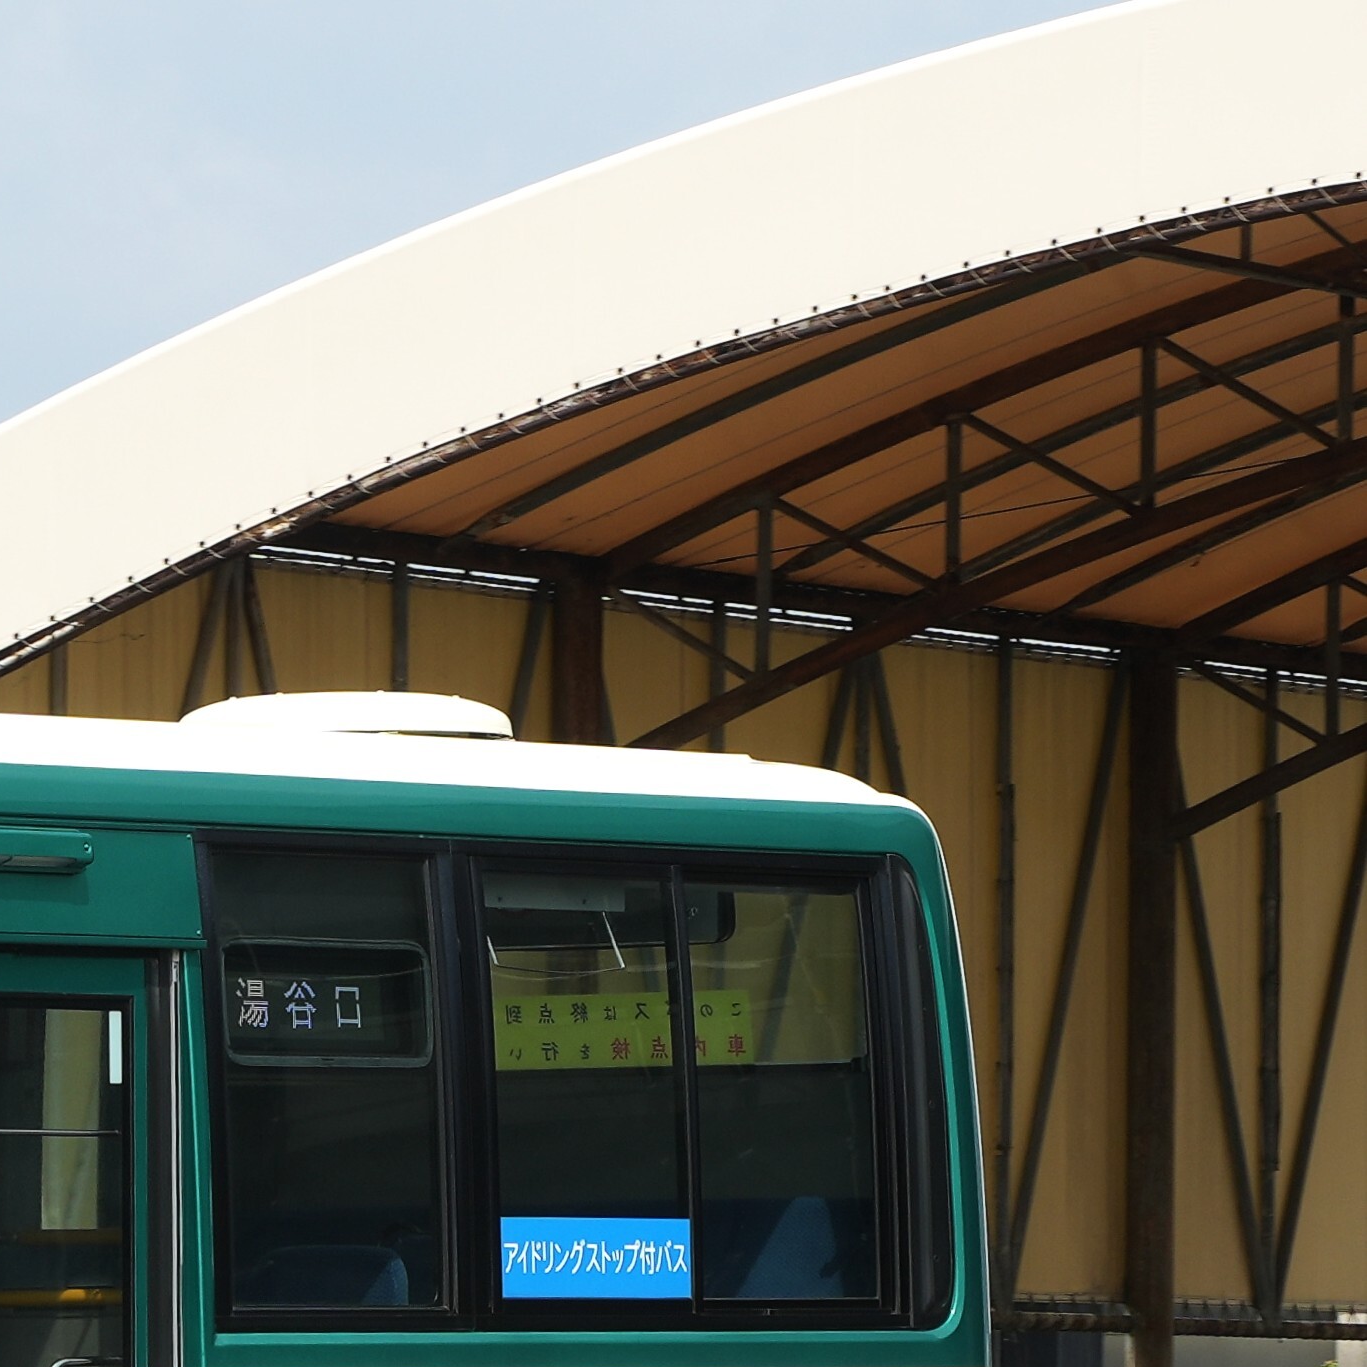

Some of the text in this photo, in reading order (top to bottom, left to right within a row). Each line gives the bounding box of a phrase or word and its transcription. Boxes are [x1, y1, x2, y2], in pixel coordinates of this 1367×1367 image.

[236, 977, 362, 1029] 湯谷口
[503, 1239, 688, 1275] アイドリングストップ付バス
